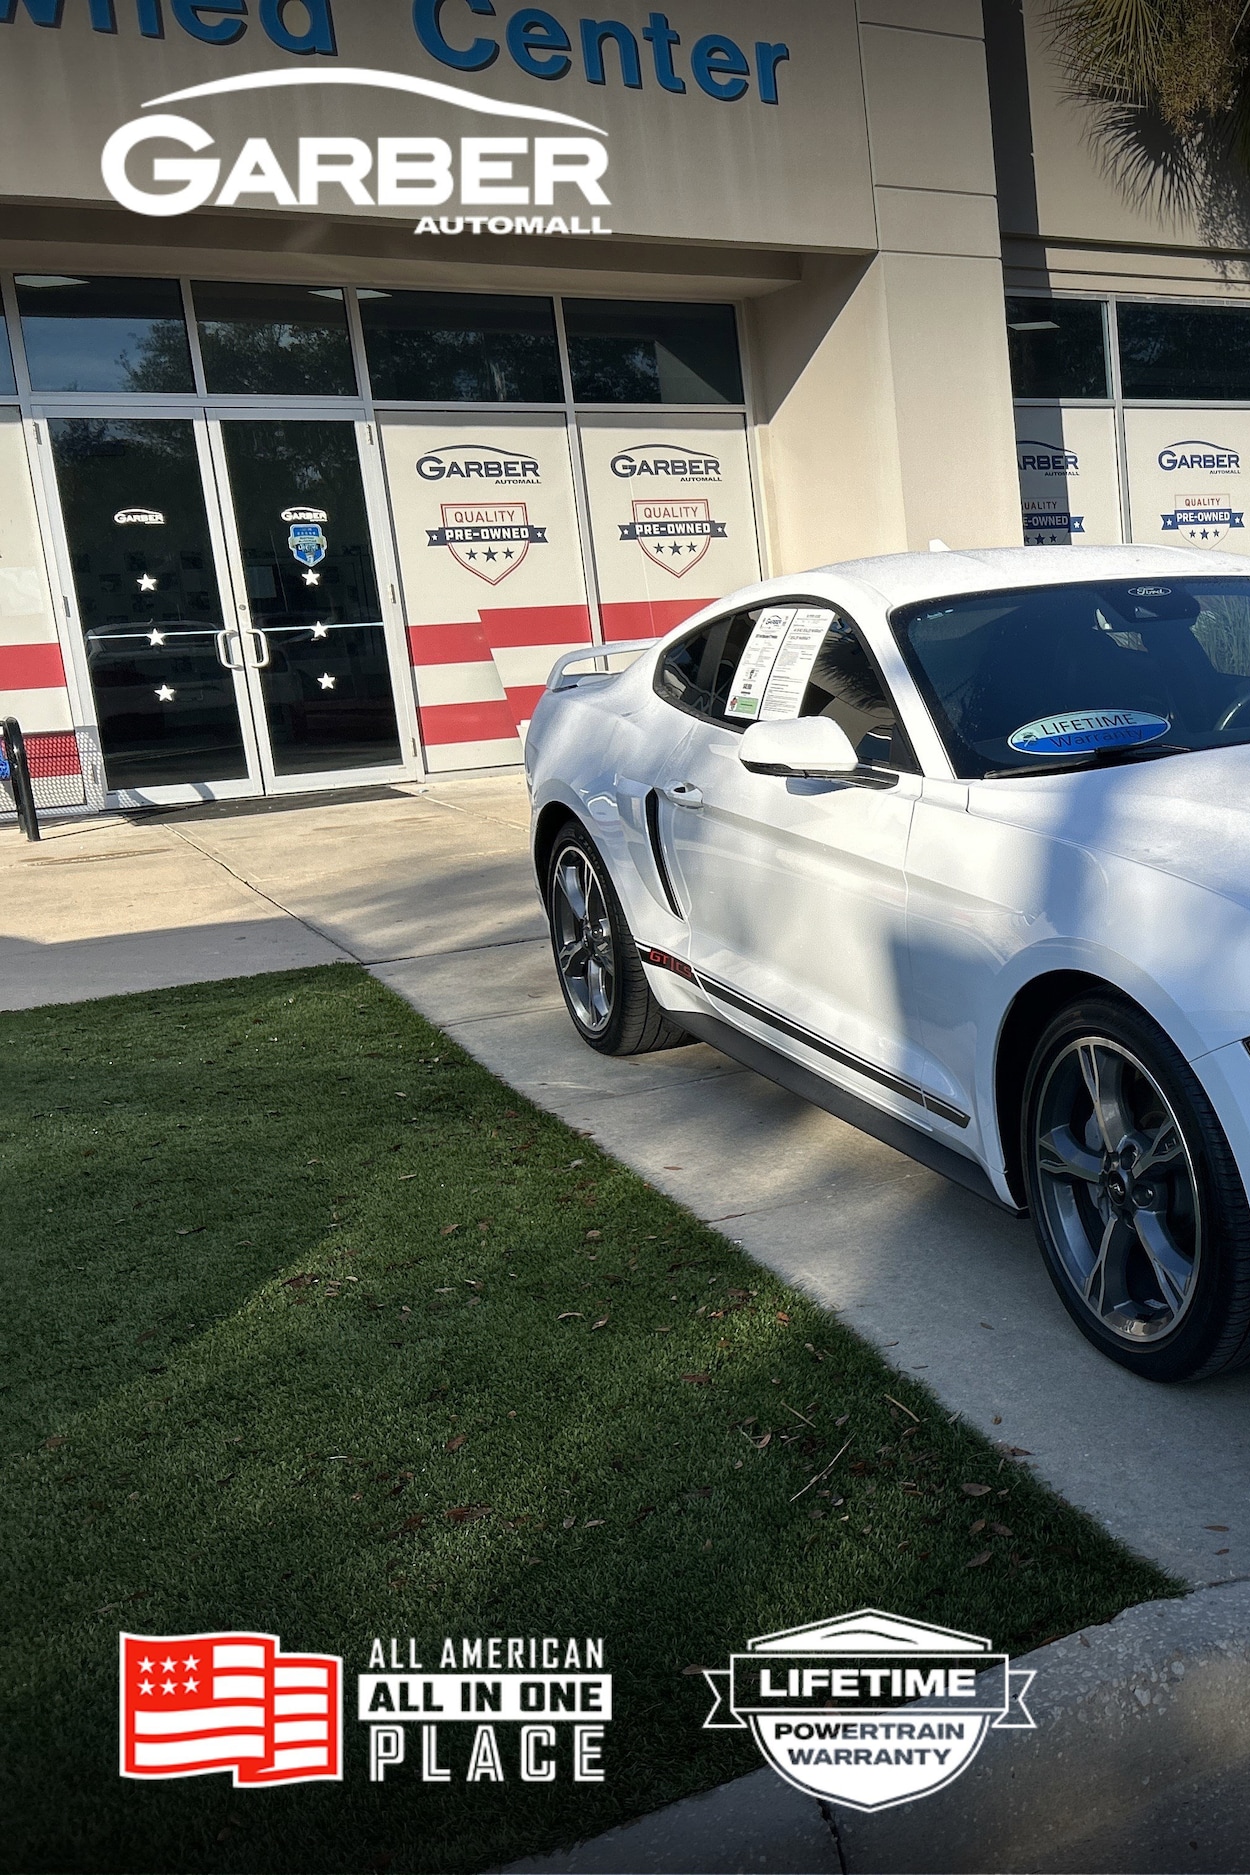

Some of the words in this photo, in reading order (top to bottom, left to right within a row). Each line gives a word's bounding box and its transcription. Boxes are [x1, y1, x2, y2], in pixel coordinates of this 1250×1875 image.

[413, 0, 790, 104] Center
[610, 454, 722, 478] GARBER
[1019, 455, 1079, 470] RBER
[1158, 449, 1241, 471] GARBER
[416, 455, 541, 481] GARBER
[1022, 501, 1057, 510] UALITY
[1184, 498, 1221, 507] QUALITY
[454, 510, 516, 523] QUALITY
[643, 506, 699, 520] QUALITY
[1176, 511, 1230, 522] PRE-OWNED
[445, 527, 529, 541] PRE-OWNED
[635, 522, 711, 535] PRE-OWNED
[1041, 713, 1138, 736] LIFETIME
[1050, 727, 1143, 748] Warranty
